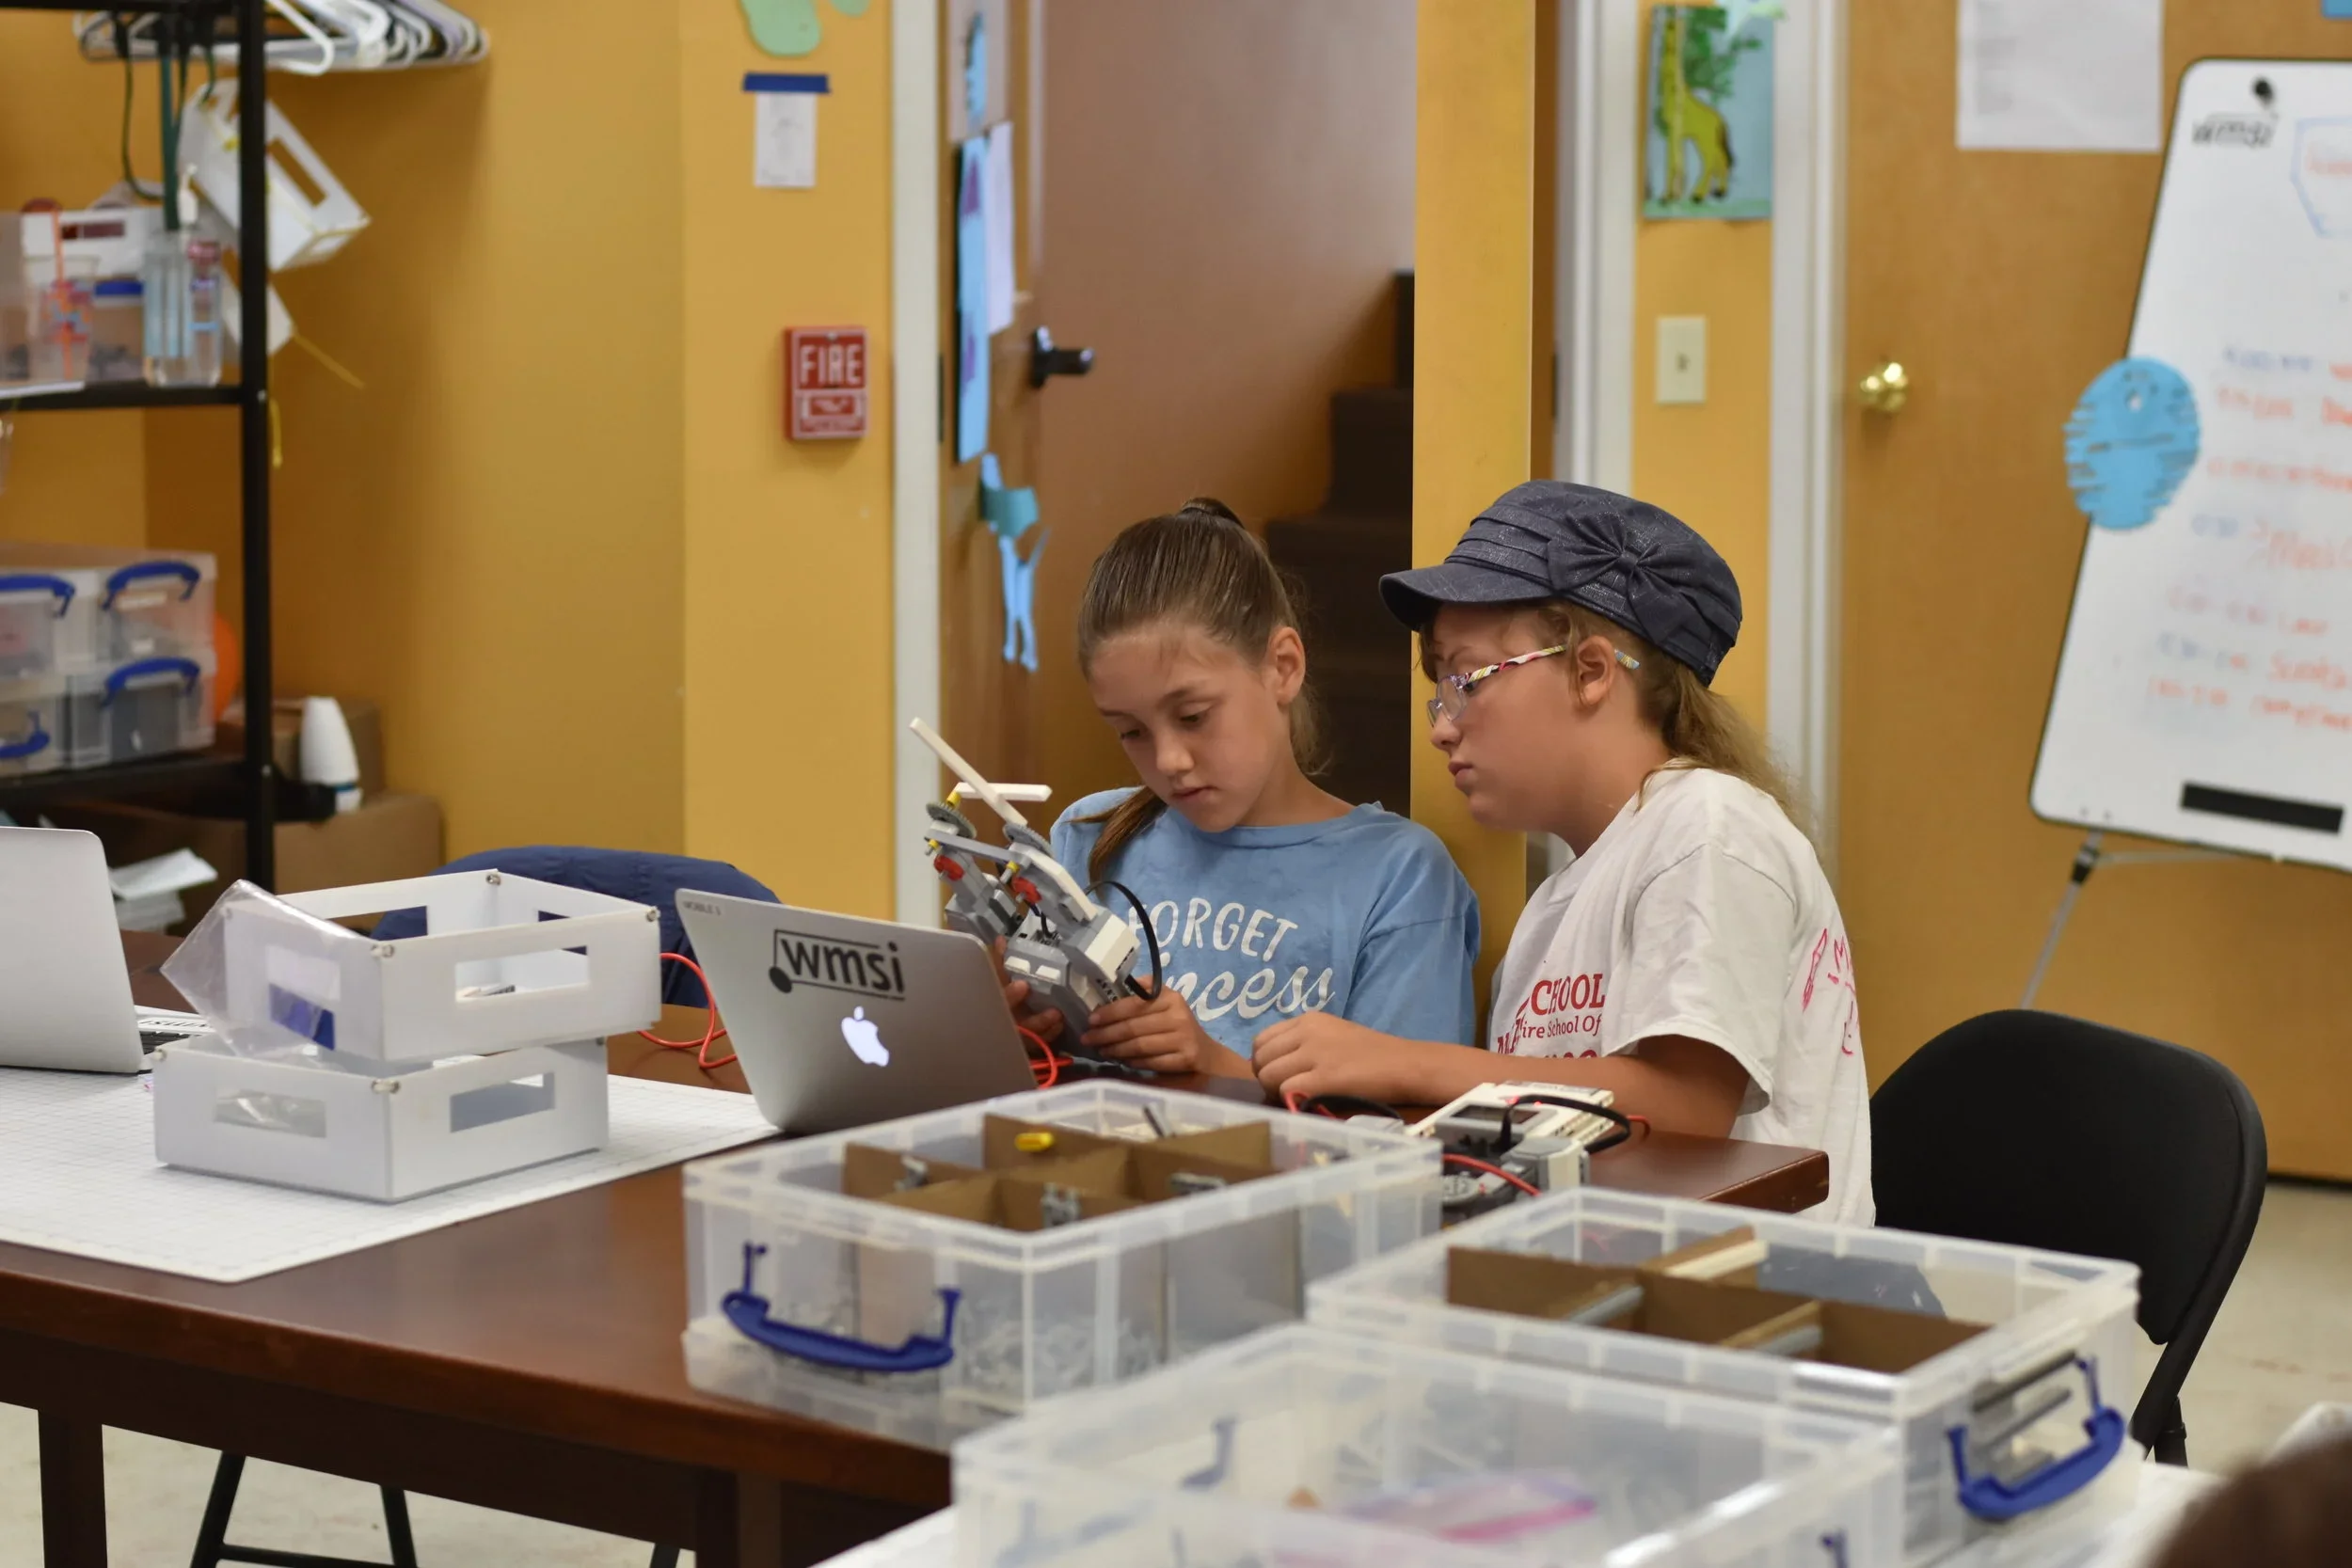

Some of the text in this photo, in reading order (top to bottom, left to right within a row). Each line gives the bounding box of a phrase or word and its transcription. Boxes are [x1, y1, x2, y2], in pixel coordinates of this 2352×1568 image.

[801, 344, 863, 385] FIRE
[1129, 897, 1298, 962] FORGET
[780, 939, 904, 993] wmsi
[1516, 974, 1605, 1019] CHOOL
[1520, 1015, 1546, 1038] ire
[1548, 1017, 1579, 1037] School
[1582, 1015, 1601, 1036] Of
